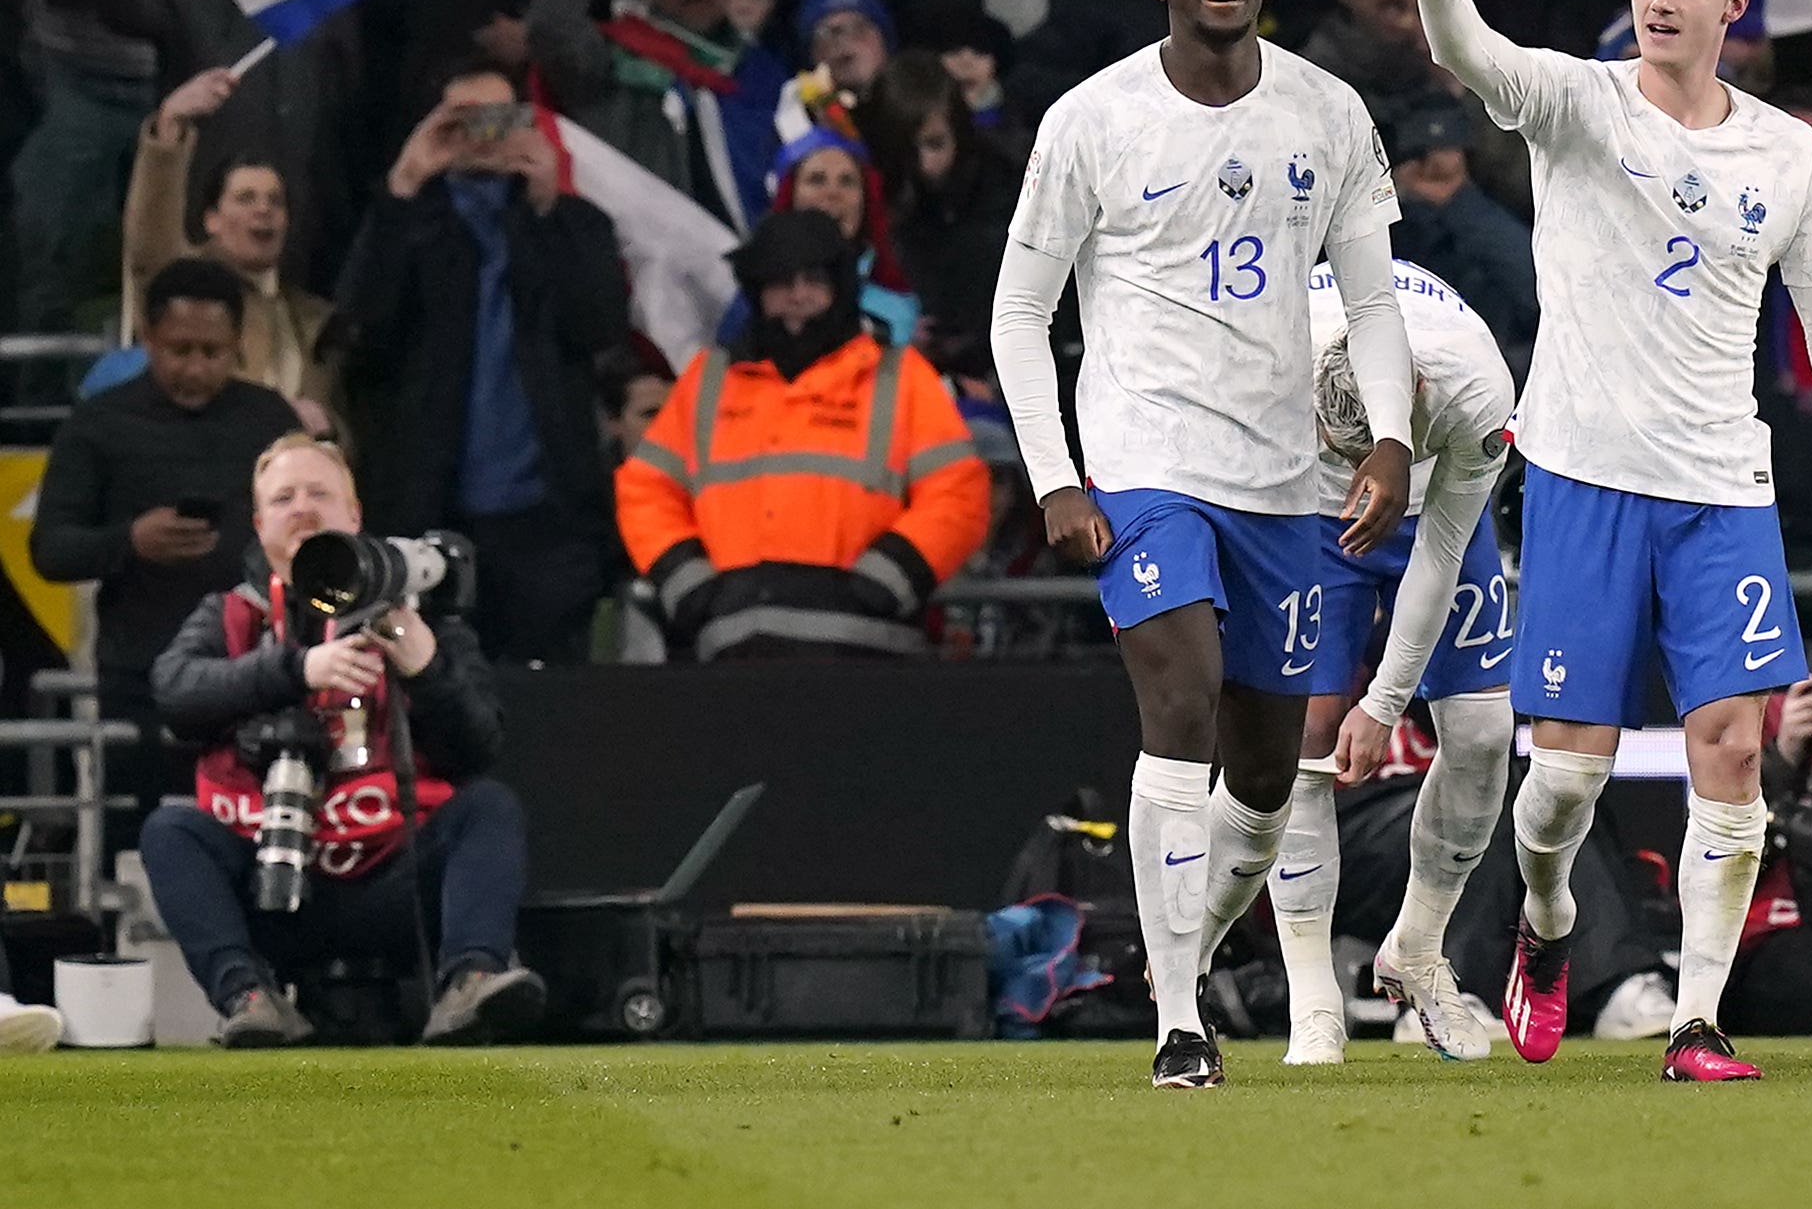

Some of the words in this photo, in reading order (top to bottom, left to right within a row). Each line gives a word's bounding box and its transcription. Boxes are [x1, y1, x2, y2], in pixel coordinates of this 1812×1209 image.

[1199, 236, 1267, 302] 13
[1654, 235, 1700, 297] 2
[1278, 583, 1323, 654] 13
[1450, 574, 1514, 649] 22
[1735, 574, 1782, 644] 2
